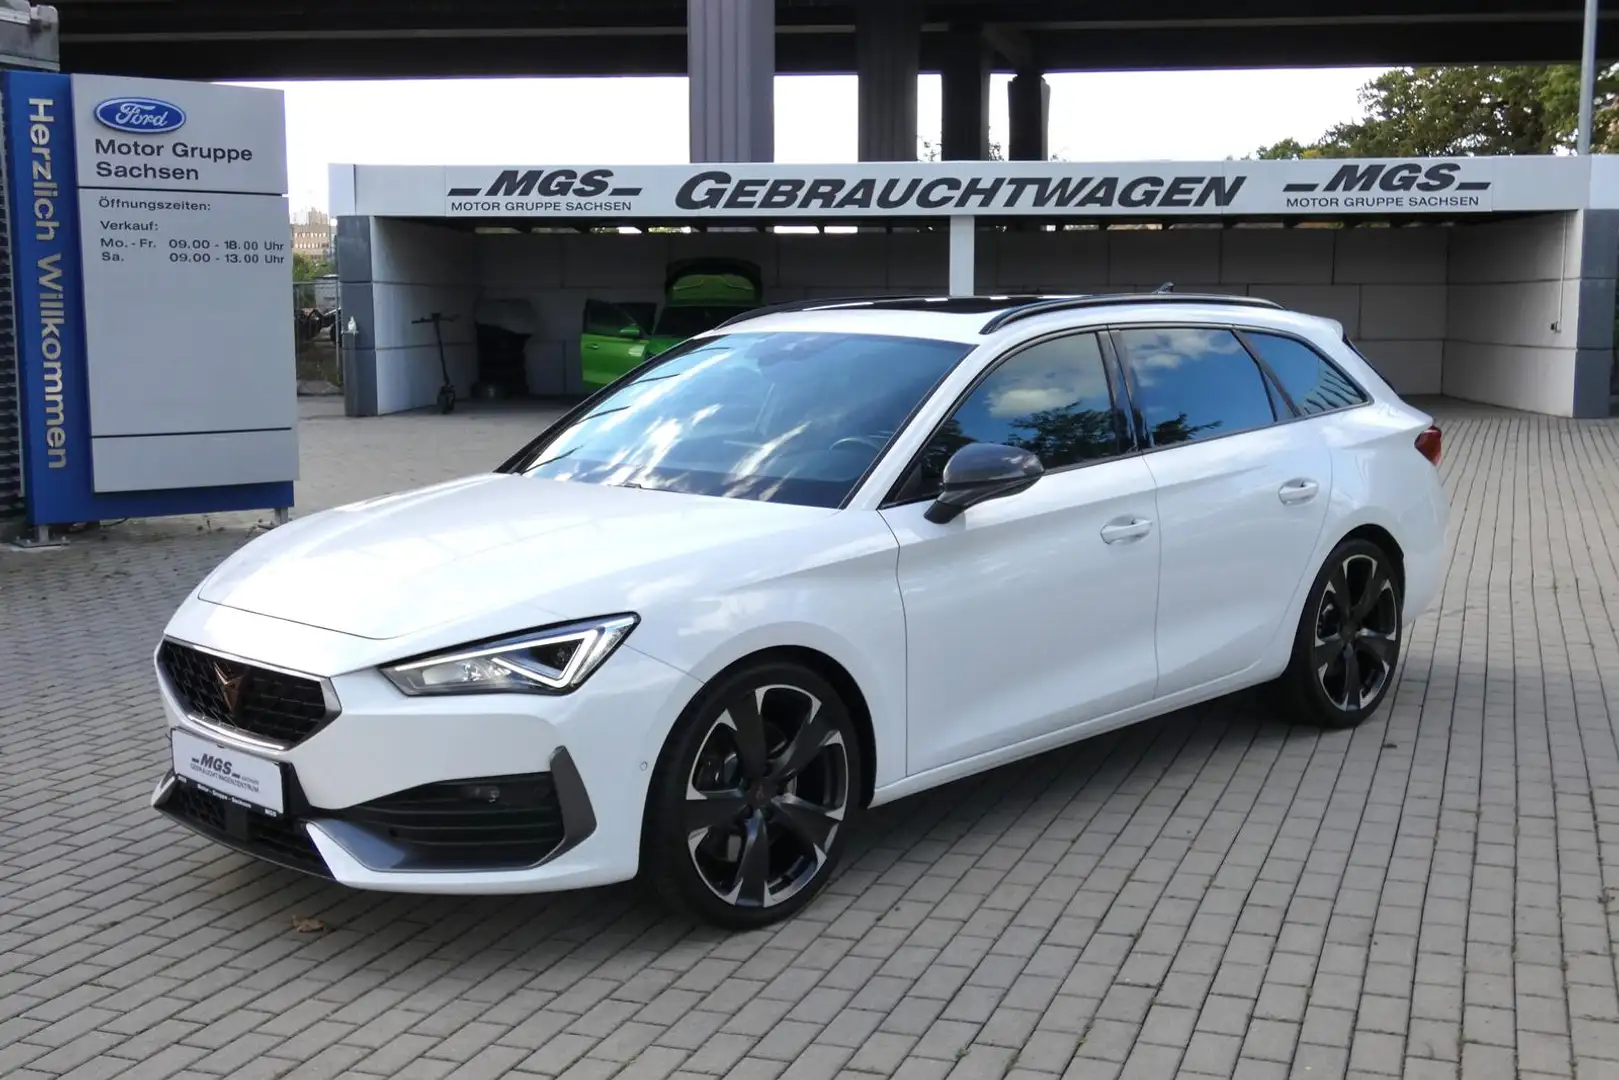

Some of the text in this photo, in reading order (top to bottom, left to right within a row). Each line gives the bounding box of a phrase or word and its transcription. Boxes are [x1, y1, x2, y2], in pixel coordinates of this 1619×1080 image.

[115, 103, 168, 127] Ford
[95, 139, 253, 164] Motor Gruppe
[96, 162, 199, 180] Sachsen
[1323, 163, 1461, 192] MGS
[485, 169, 614, 197] MGS
[675, 171, 1247, 211] GEBRAUCHTWAGEN
[99, 196, 211, 211] Öffnungszeiten:
[451, 202, 632, 211] MOTOR GRUPPE SACHSEN
[1286, 196, 1479, 208] MOTOR GRUPPE SACHSEN
[100, 220, 159, 231] Verkauf:
[100, 238, 128, 248] Mo.
[139, 239, 156, 248] Fr.
[169, 239, 210, 250] 09.00
[224, 240, 259, 251] 18.00
[264, 241, 284, 251] Uhr
[102, 252, 124, 262] Sa.
[169, 252, 211, 263] 09.00
[225, 254, 259, 264] 13.00
[264, 254, 284, 264] Uhr
[29, 98, 67, 469] Herzlich Willkommen
[200, 753, 232, 775] MGS
